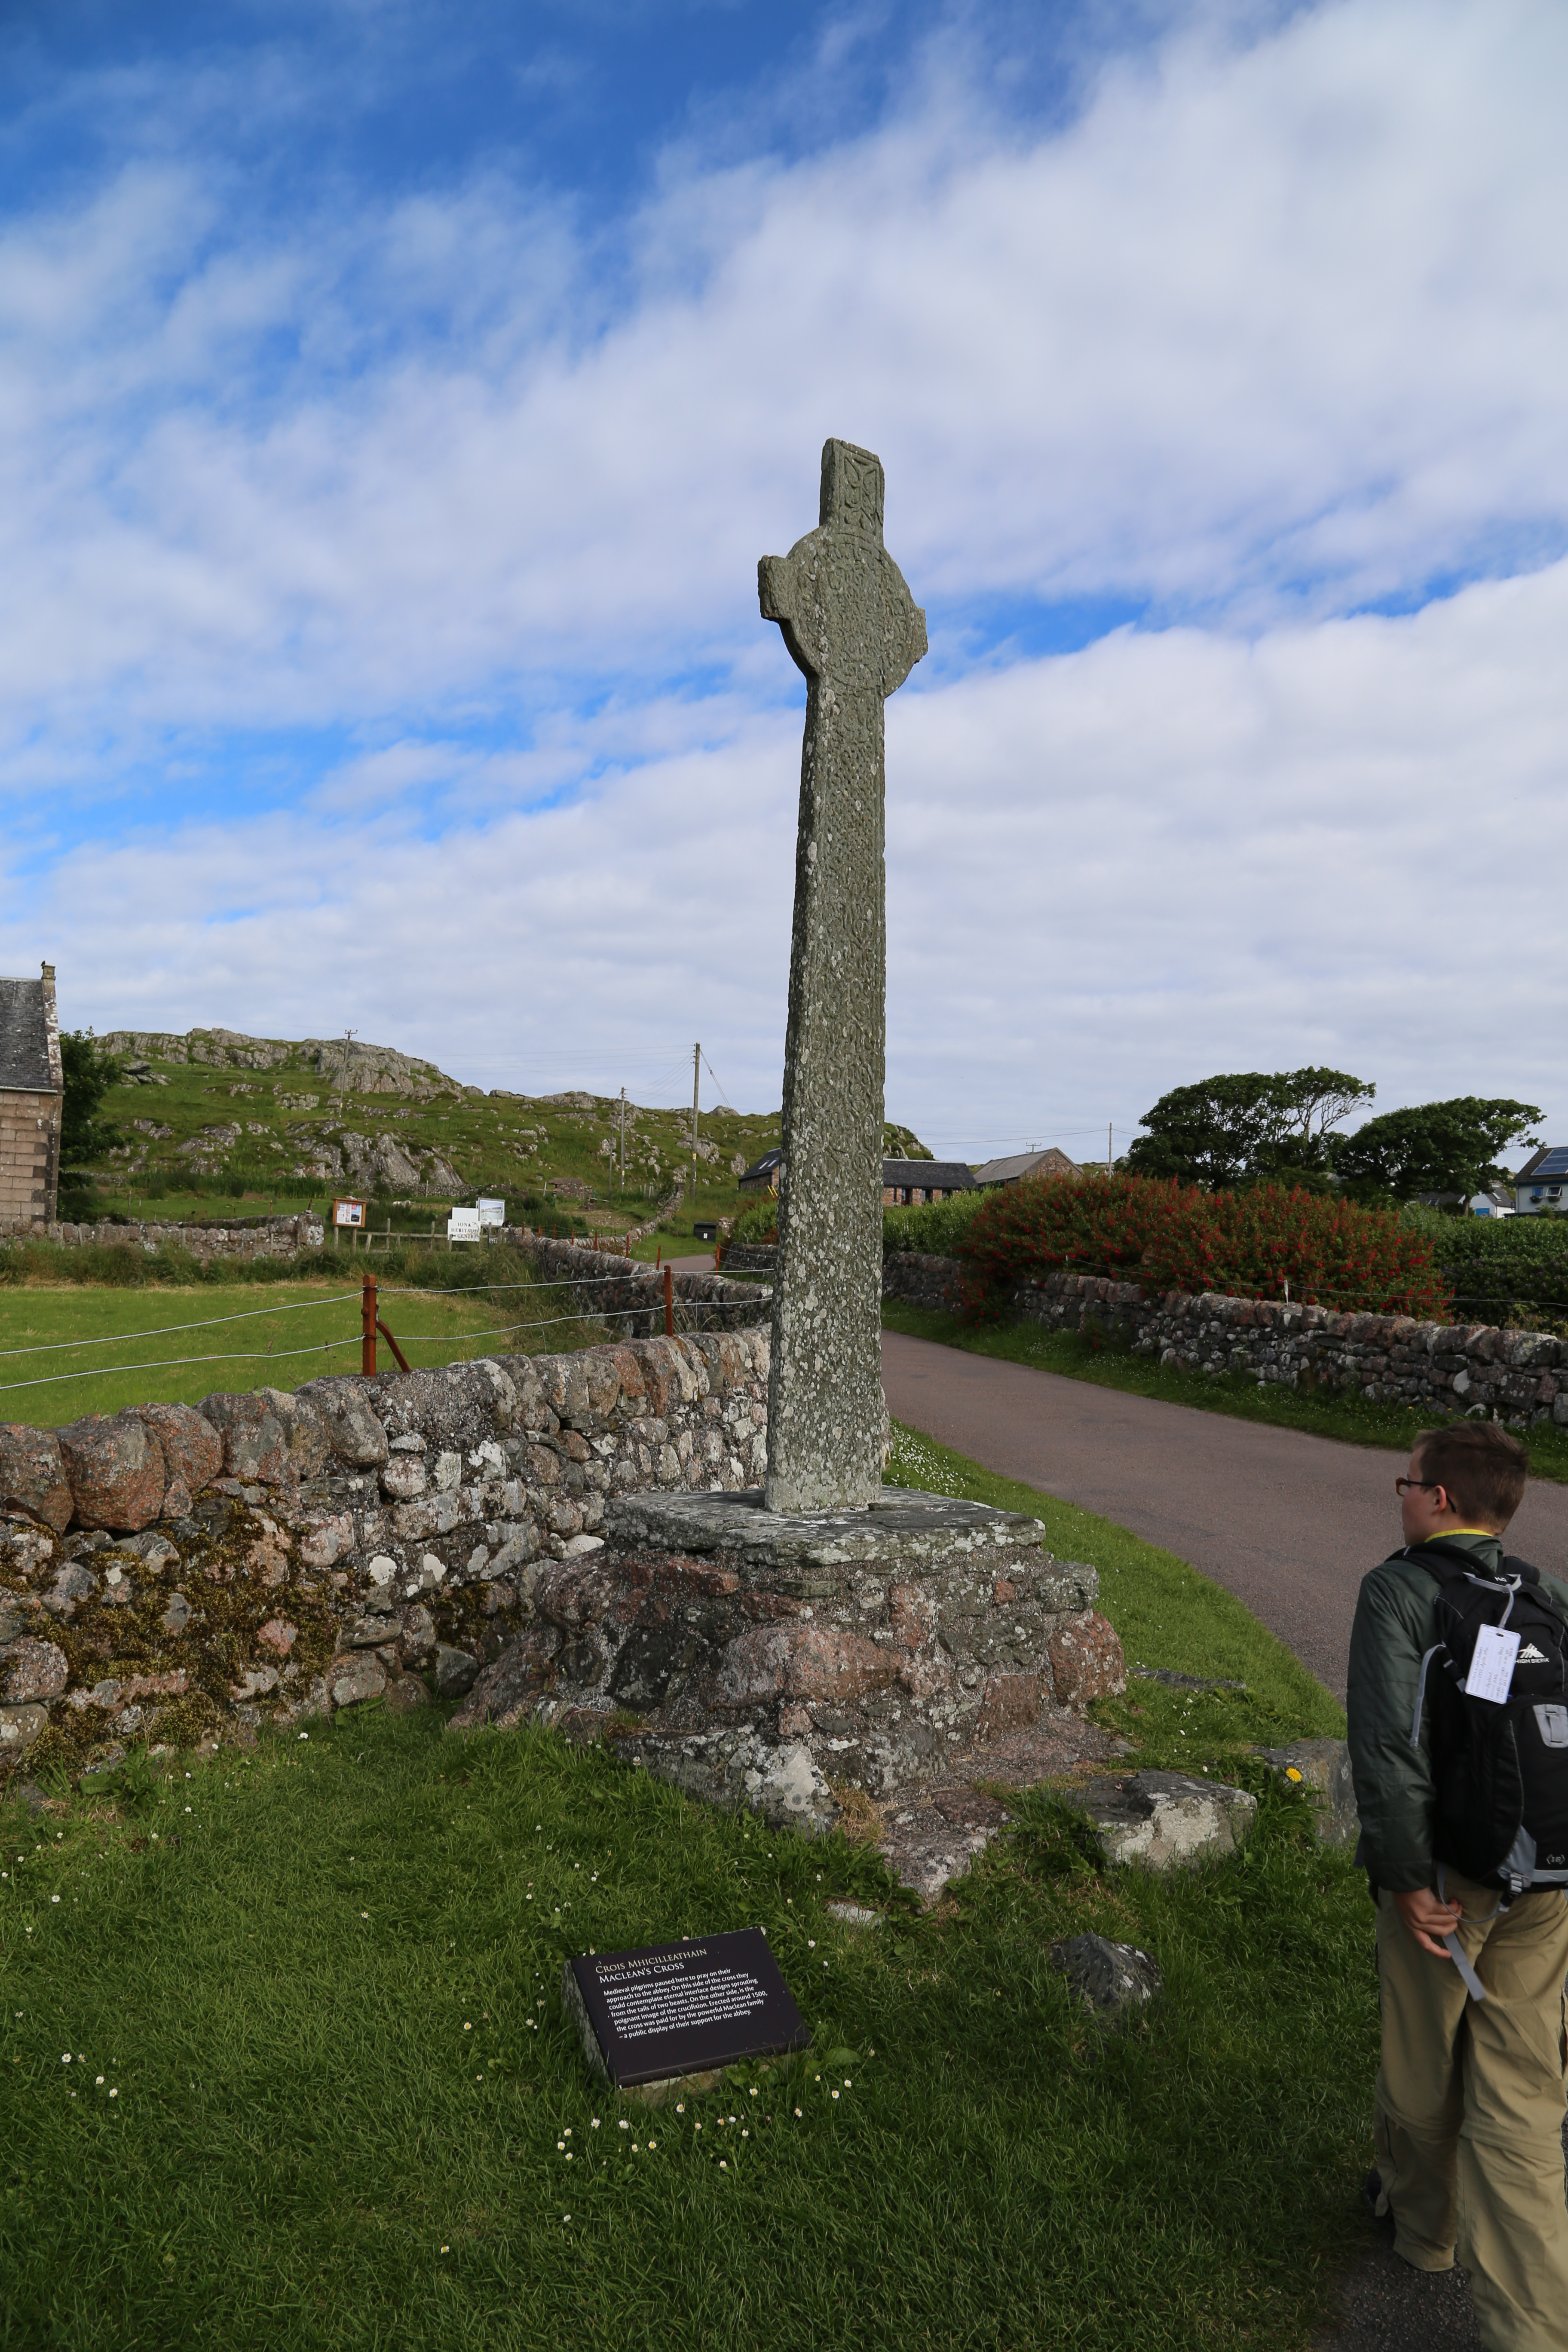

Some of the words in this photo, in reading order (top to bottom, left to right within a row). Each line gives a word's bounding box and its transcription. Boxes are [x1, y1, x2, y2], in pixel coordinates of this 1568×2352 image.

[595, 1963, 625, 1973] CROIS
[628, 1948, 707, 1968] MHICILLEATHAIN
[599, 1967, 651, 1984] MACLEAN'S
[653, 1962, 684, 1973] CROSS
[603, 1986, 630, 1996] Medieval
[631, 1983, 654, 1993] pilgrims
[654, 1978, 675, 1988] paused
[606, 1993, 634, 2004] approach
[609, 2001, 626, 2010] could
[626, 1996, 663, 2007] contemplate
[664, 1991, 684, 2000] eternal
[684, 1988, 709, 1996] interlace
[710, 1983, 731, 1991] designs
[731, 1978, 758, 1988] sprouting
[614, 2015, 641, 2026] poignant
[677, 2003, 709, 2012] crucifixion.
[708, 1997, 730, 2006] Erected
[731, 1993, 751, 2002] around
[655, 2016, 669, 2026] paid
[697, 2006, 723, 2018] powerful
[723, 2003, 747, 2011] Maclean
[747, 1998, 764, 2006] family
[628, 2029, 647, 2039] public
[648, 2025, 668, 2034] display
[690, 2016, 714, 2025] support
